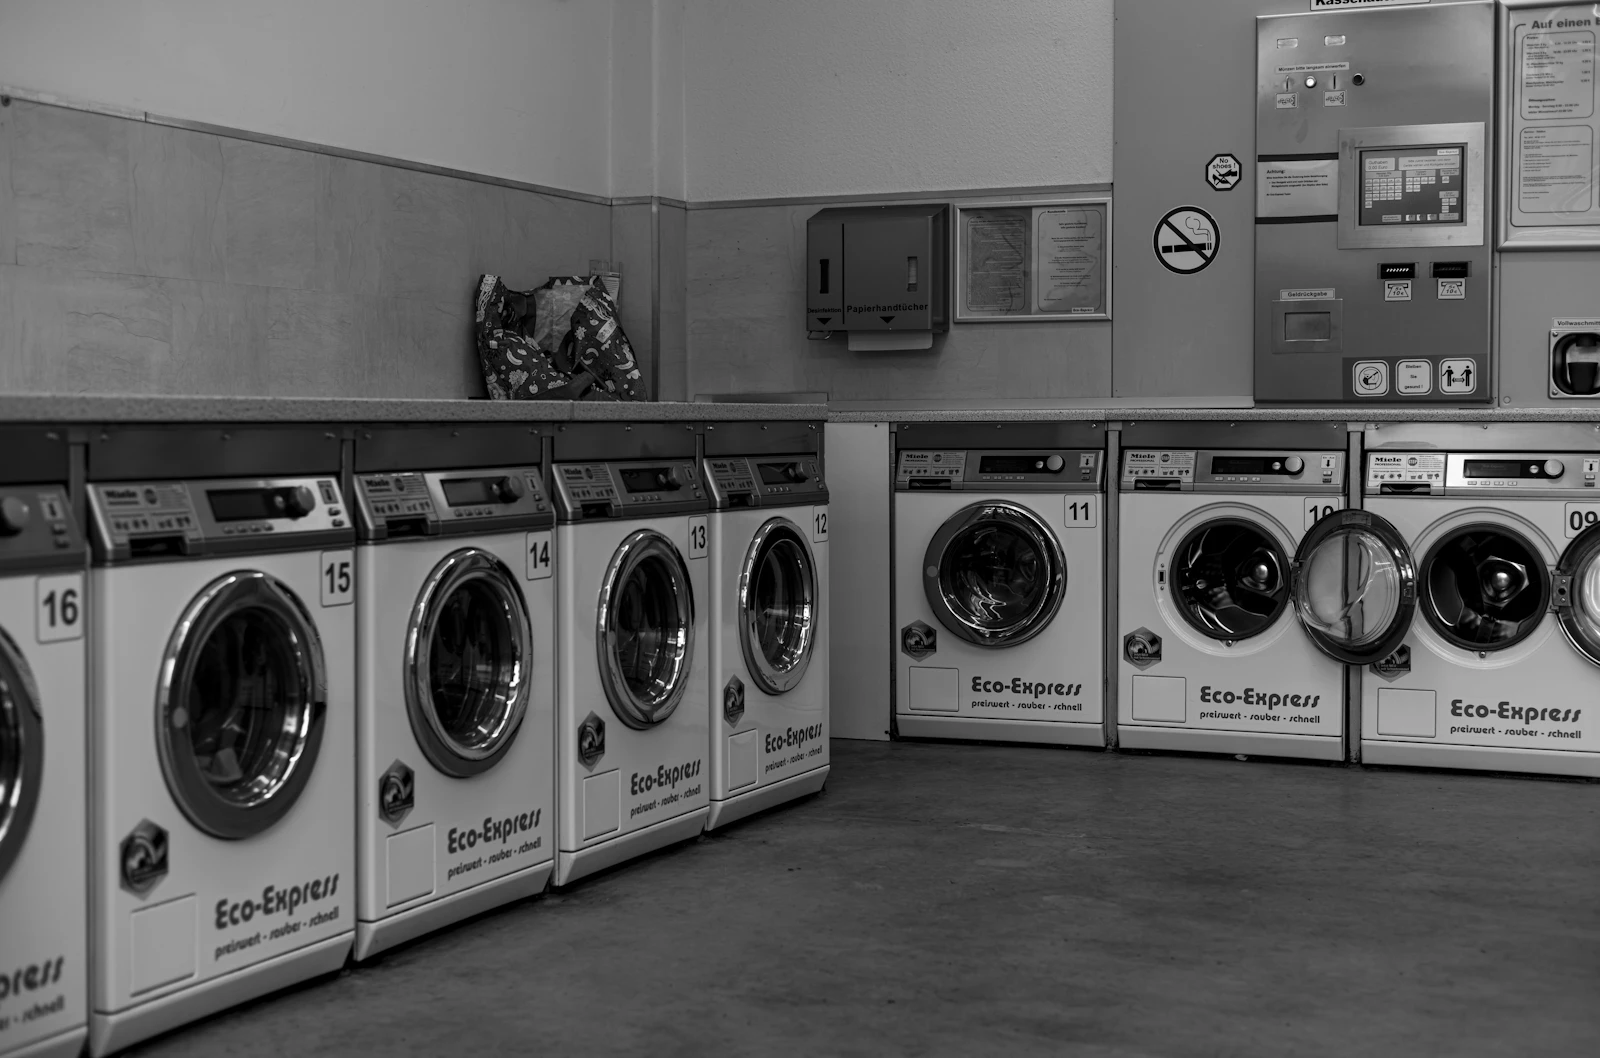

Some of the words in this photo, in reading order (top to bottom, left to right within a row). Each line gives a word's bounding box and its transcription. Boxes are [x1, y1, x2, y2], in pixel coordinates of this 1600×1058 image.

[1531, 19, 1552, 29] Auf
[1556, 18, 1591, 28] einen
[846, 303, 928, 314] Papierhandtücher
[815, 513, 827, 534] 12
[1068, 502, 1089, 520] 11
[1570, 511, 1598, 531] 09
[691, 524, 706, 550] 13
[529, 541, 550, 569] 14
[325, 562, 351, 594] 15
[43, 588, 78, 628] 16
[972, 676, 1082, 698] Eco-Express
[1199, 686, 1321, 711] Eco-Express
[972, 700, 1009, 709] preiswert
[1017, 701, 1045, 710] sauber
[1053, 702, 1082, 711] schnell
[1199, 711, 1239, 720] preiswert
[1250, 713, 1281, 722] sauber
[1290, 714, 1321, 723] schnell
[1451, 699, 1582, 725] Eco-Express
[765, 723, 822, 754] Eco-Express
[1451, 726, 1496, 735] preiswert
[1505, 728, 1538, 737] sauber
[1547, 730, 1582, 739] schnell
[630, 759, 701, 796] Eco-Express
[630, 799, 657, 819] preiswert
[661, 793, 679, 807] sauber
[683, 784, 701, 799] schnell
[447, 808, 541, 855] Eco-Express
[447, 856, 482, 881] preiswert
[488, 848, 512, 865] sauber
[518, 836, 541, 855] schnell
[215, 873, 340, 931] Eco-Express
[214, 932, 261, 962] preiswert
[269, 921, 302, 940] sauber
[308, 905, 340, 928] schnell
